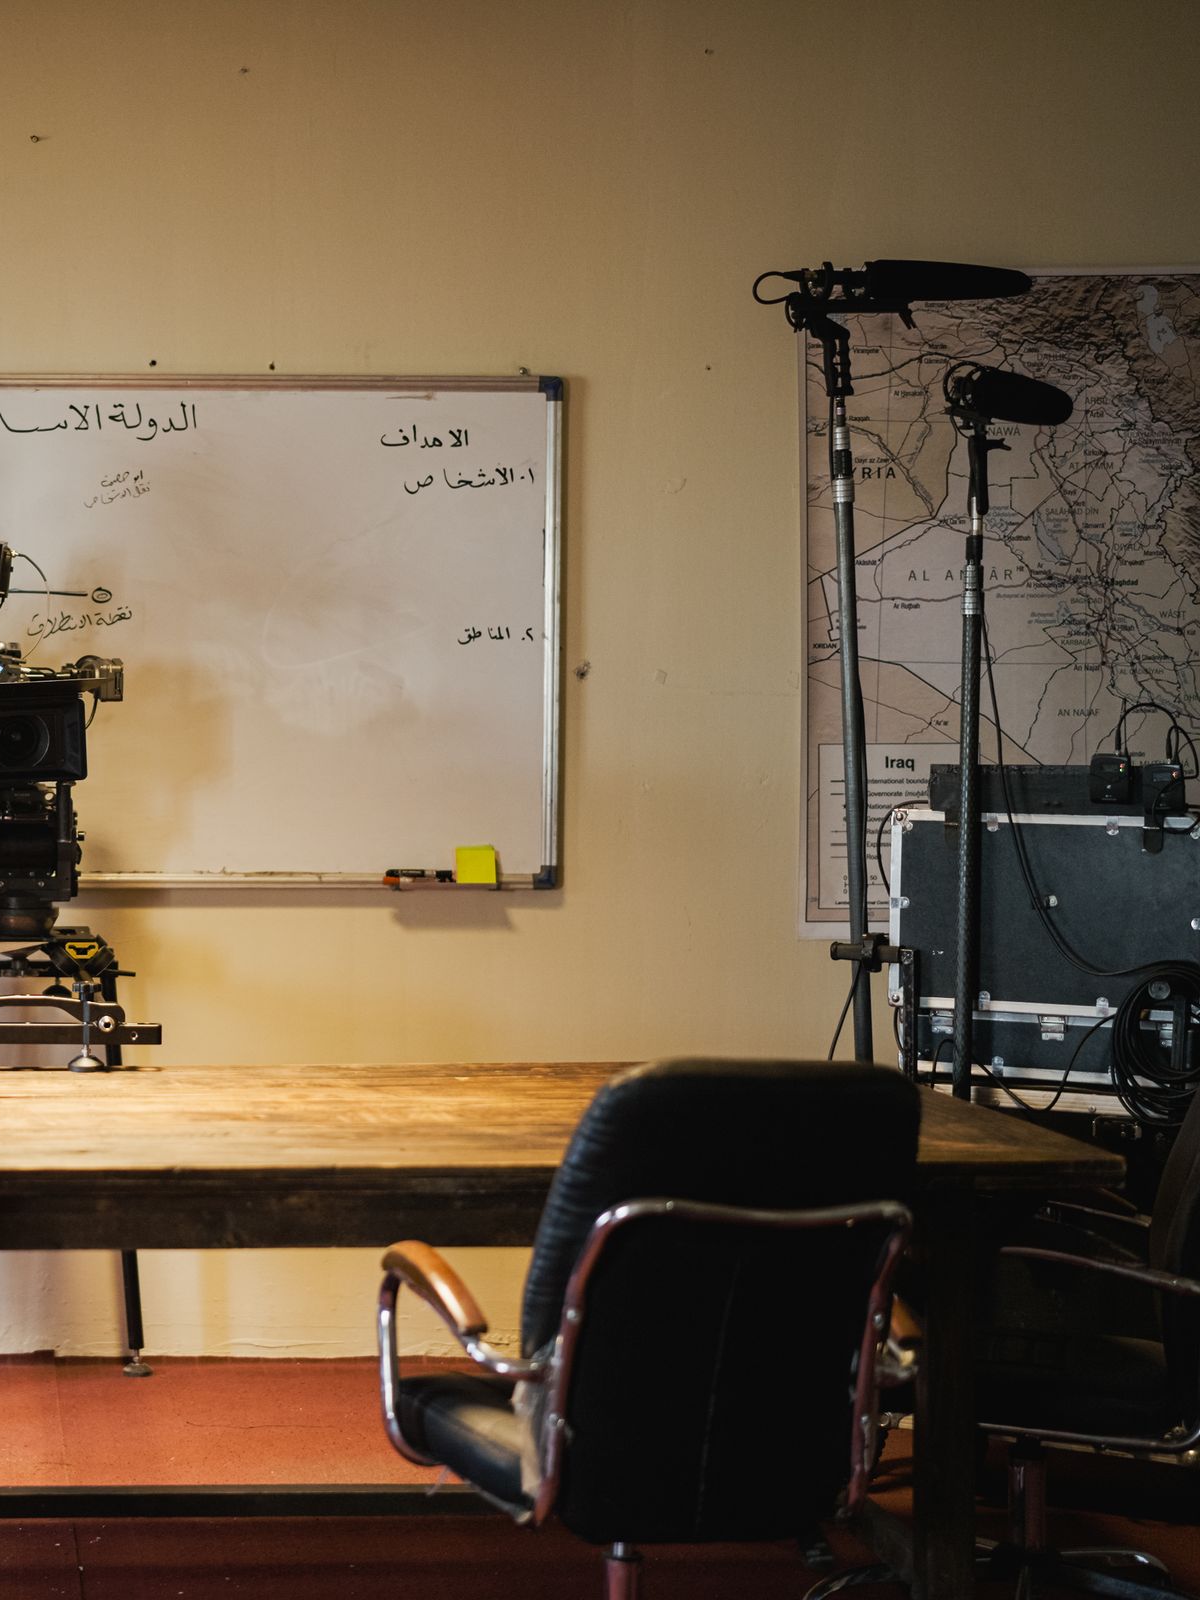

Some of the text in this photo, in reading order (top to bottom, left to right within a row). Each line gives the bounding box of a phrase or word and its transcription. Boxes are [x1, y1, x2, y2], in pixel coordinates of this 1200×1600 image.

[108, 401, 198, 440] الدولة
[851, 466, 897, 479] YRIA
[909, 570, 930, 581] AL
[1058, 708, 1072, 717] AN
[884, 756, 916, 772] Iraq
